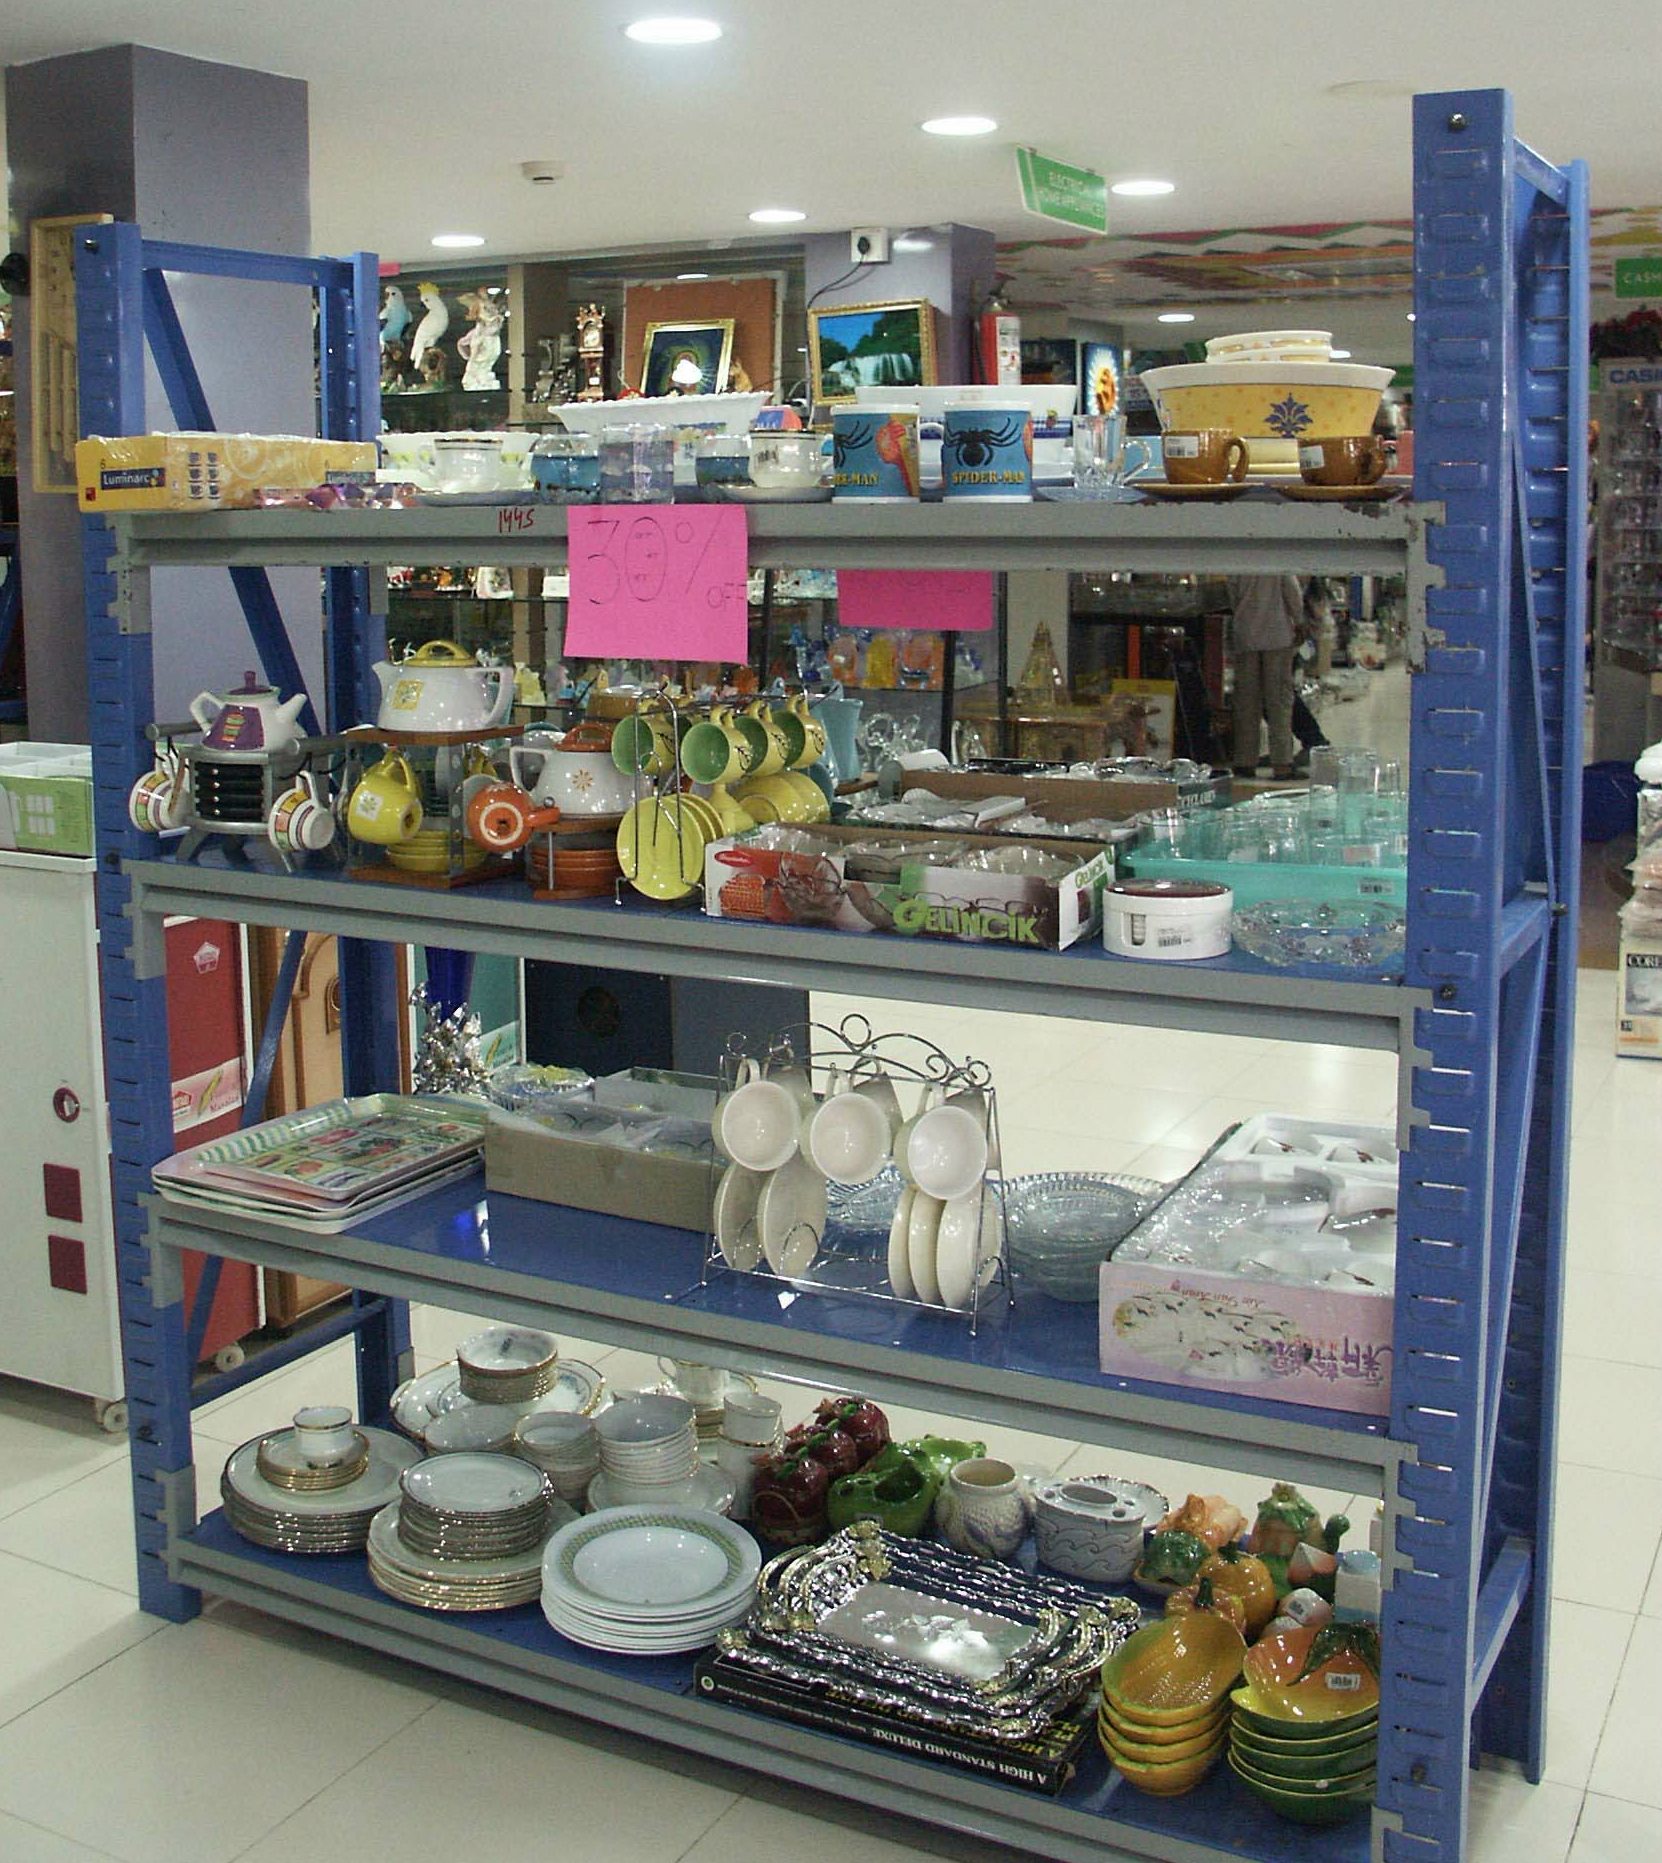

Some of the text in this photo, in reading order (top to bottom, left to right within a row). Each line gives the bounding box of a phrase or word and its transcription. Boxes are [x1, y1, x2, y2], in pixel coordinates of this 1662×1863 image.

[103, 470, 150, 486] Luminarc
[872, 1727, 1048, 1785] A HIGH STANDARD DELUXE
